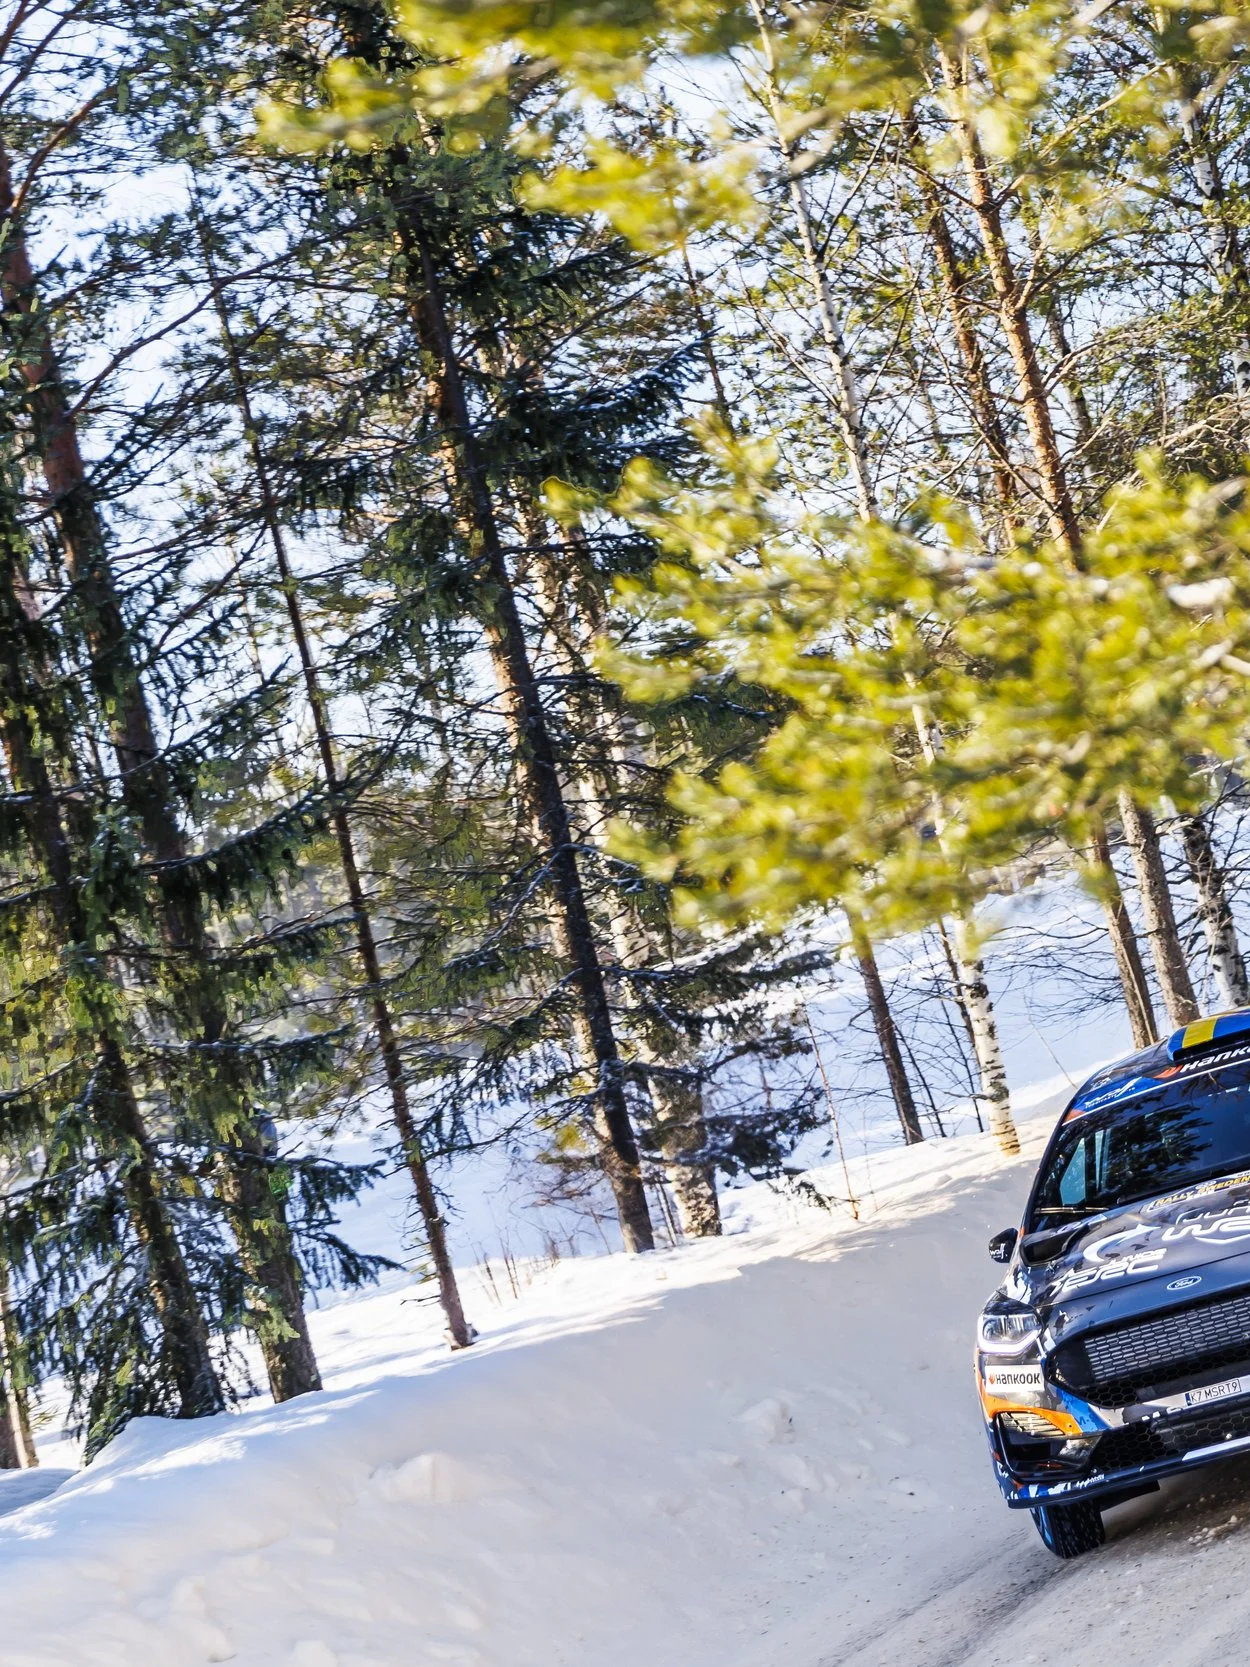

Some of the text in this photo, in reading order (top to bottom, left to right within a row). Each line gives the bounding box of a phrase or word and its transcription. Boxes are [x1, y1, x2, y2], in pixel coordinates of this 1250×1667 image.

[1155, 1191, 1194, 1206] RALLY
[1190, 1381, 1238, 1403] K7 MSRT9
